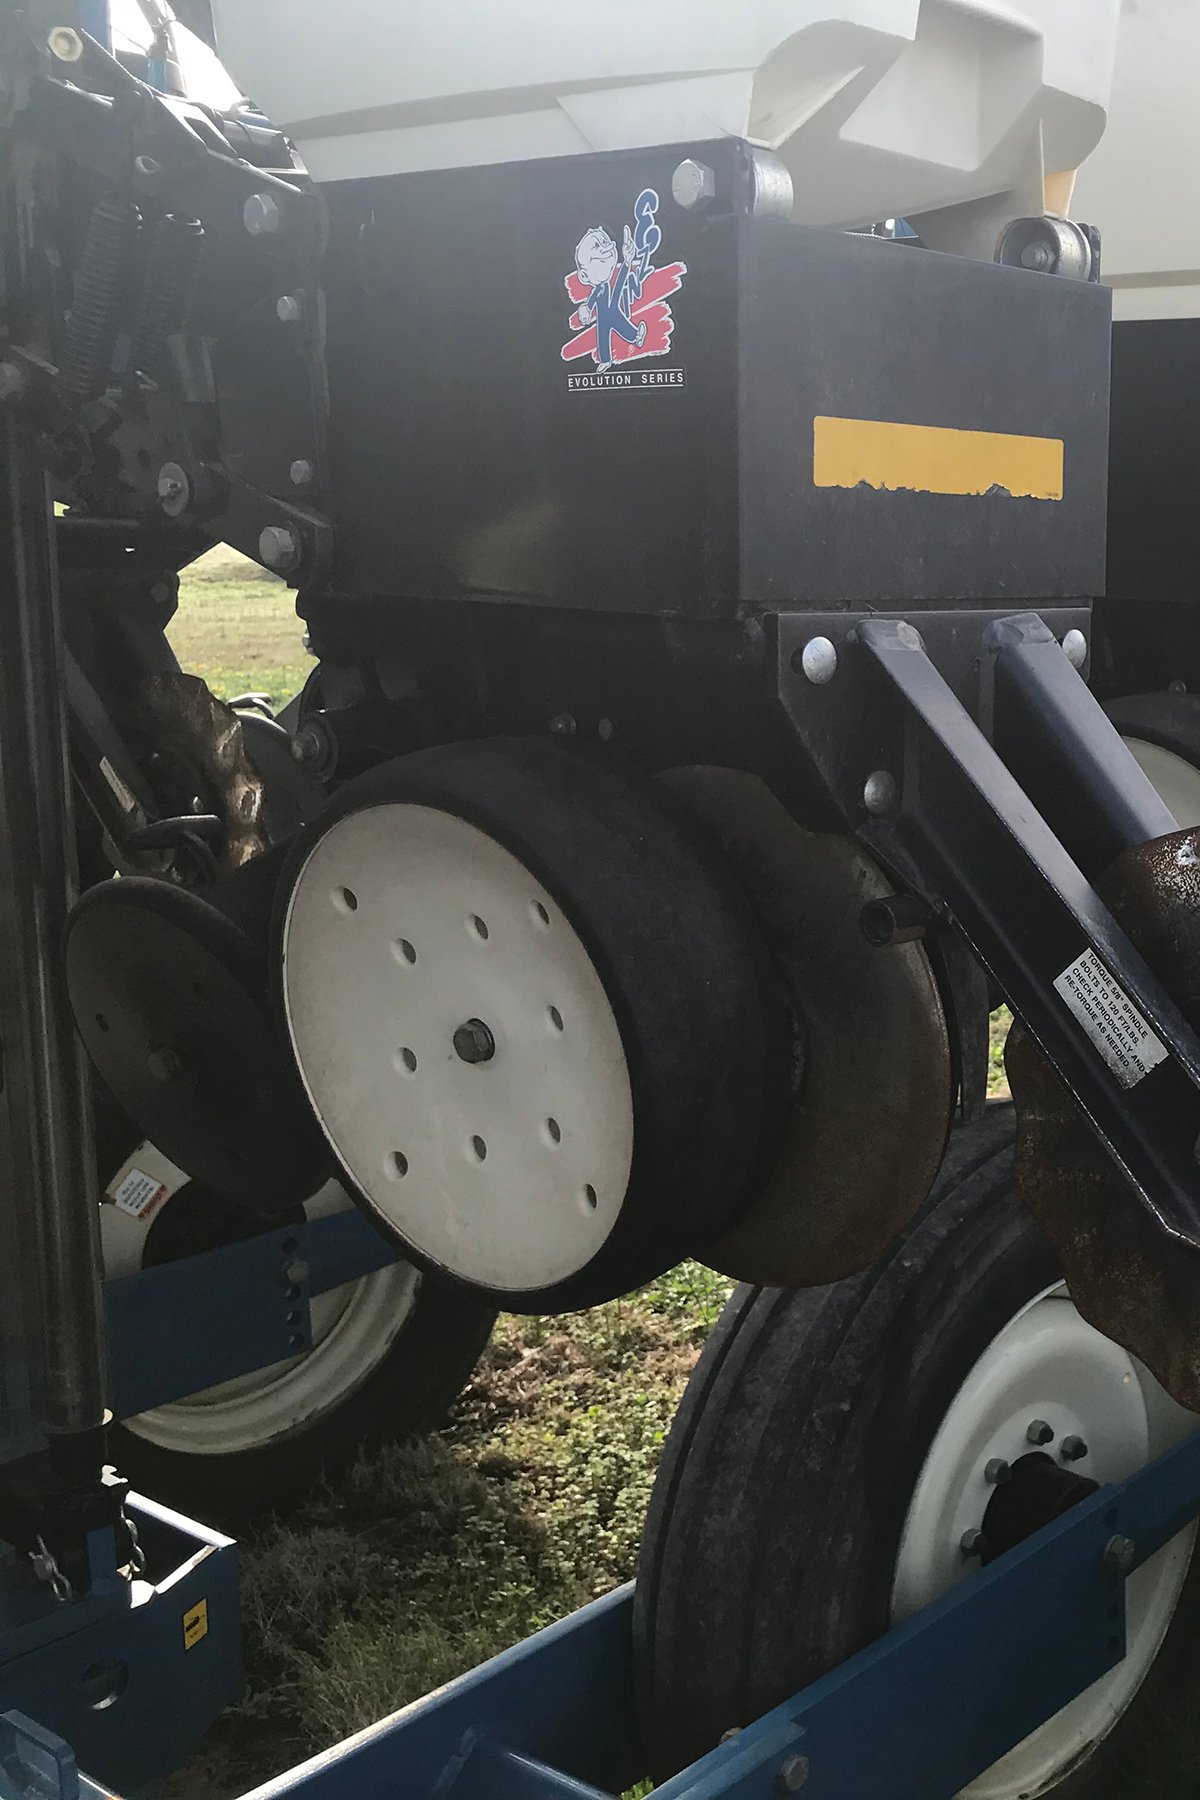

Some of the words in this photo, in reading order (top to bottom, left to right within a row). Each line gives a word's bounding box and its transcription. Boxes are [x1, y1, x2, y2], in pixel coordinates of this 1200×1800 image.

[568, 374, 631, 388] EVOLUTION
[642, 372, 684, 384] SERIES
[1064, 974, 1099, 1022] RE-TORQUE
[1096, 1021, 1107, 1035] AS
[1079, 960, 1101, 988] BOLTS
[1098, 987, 1109, 1001] TO
[1107, 1000, 1119, 1016] 120
[1088, 952, 1113, 986] TORQUE
[1121, 1003, 1149, 1039] SPINDLE
[1072, 967, 1094, 996] CHECK
[1091, 996, 1133, 1053] PERIODICALLY
[1131, 1054, 1145, 1073] AND
